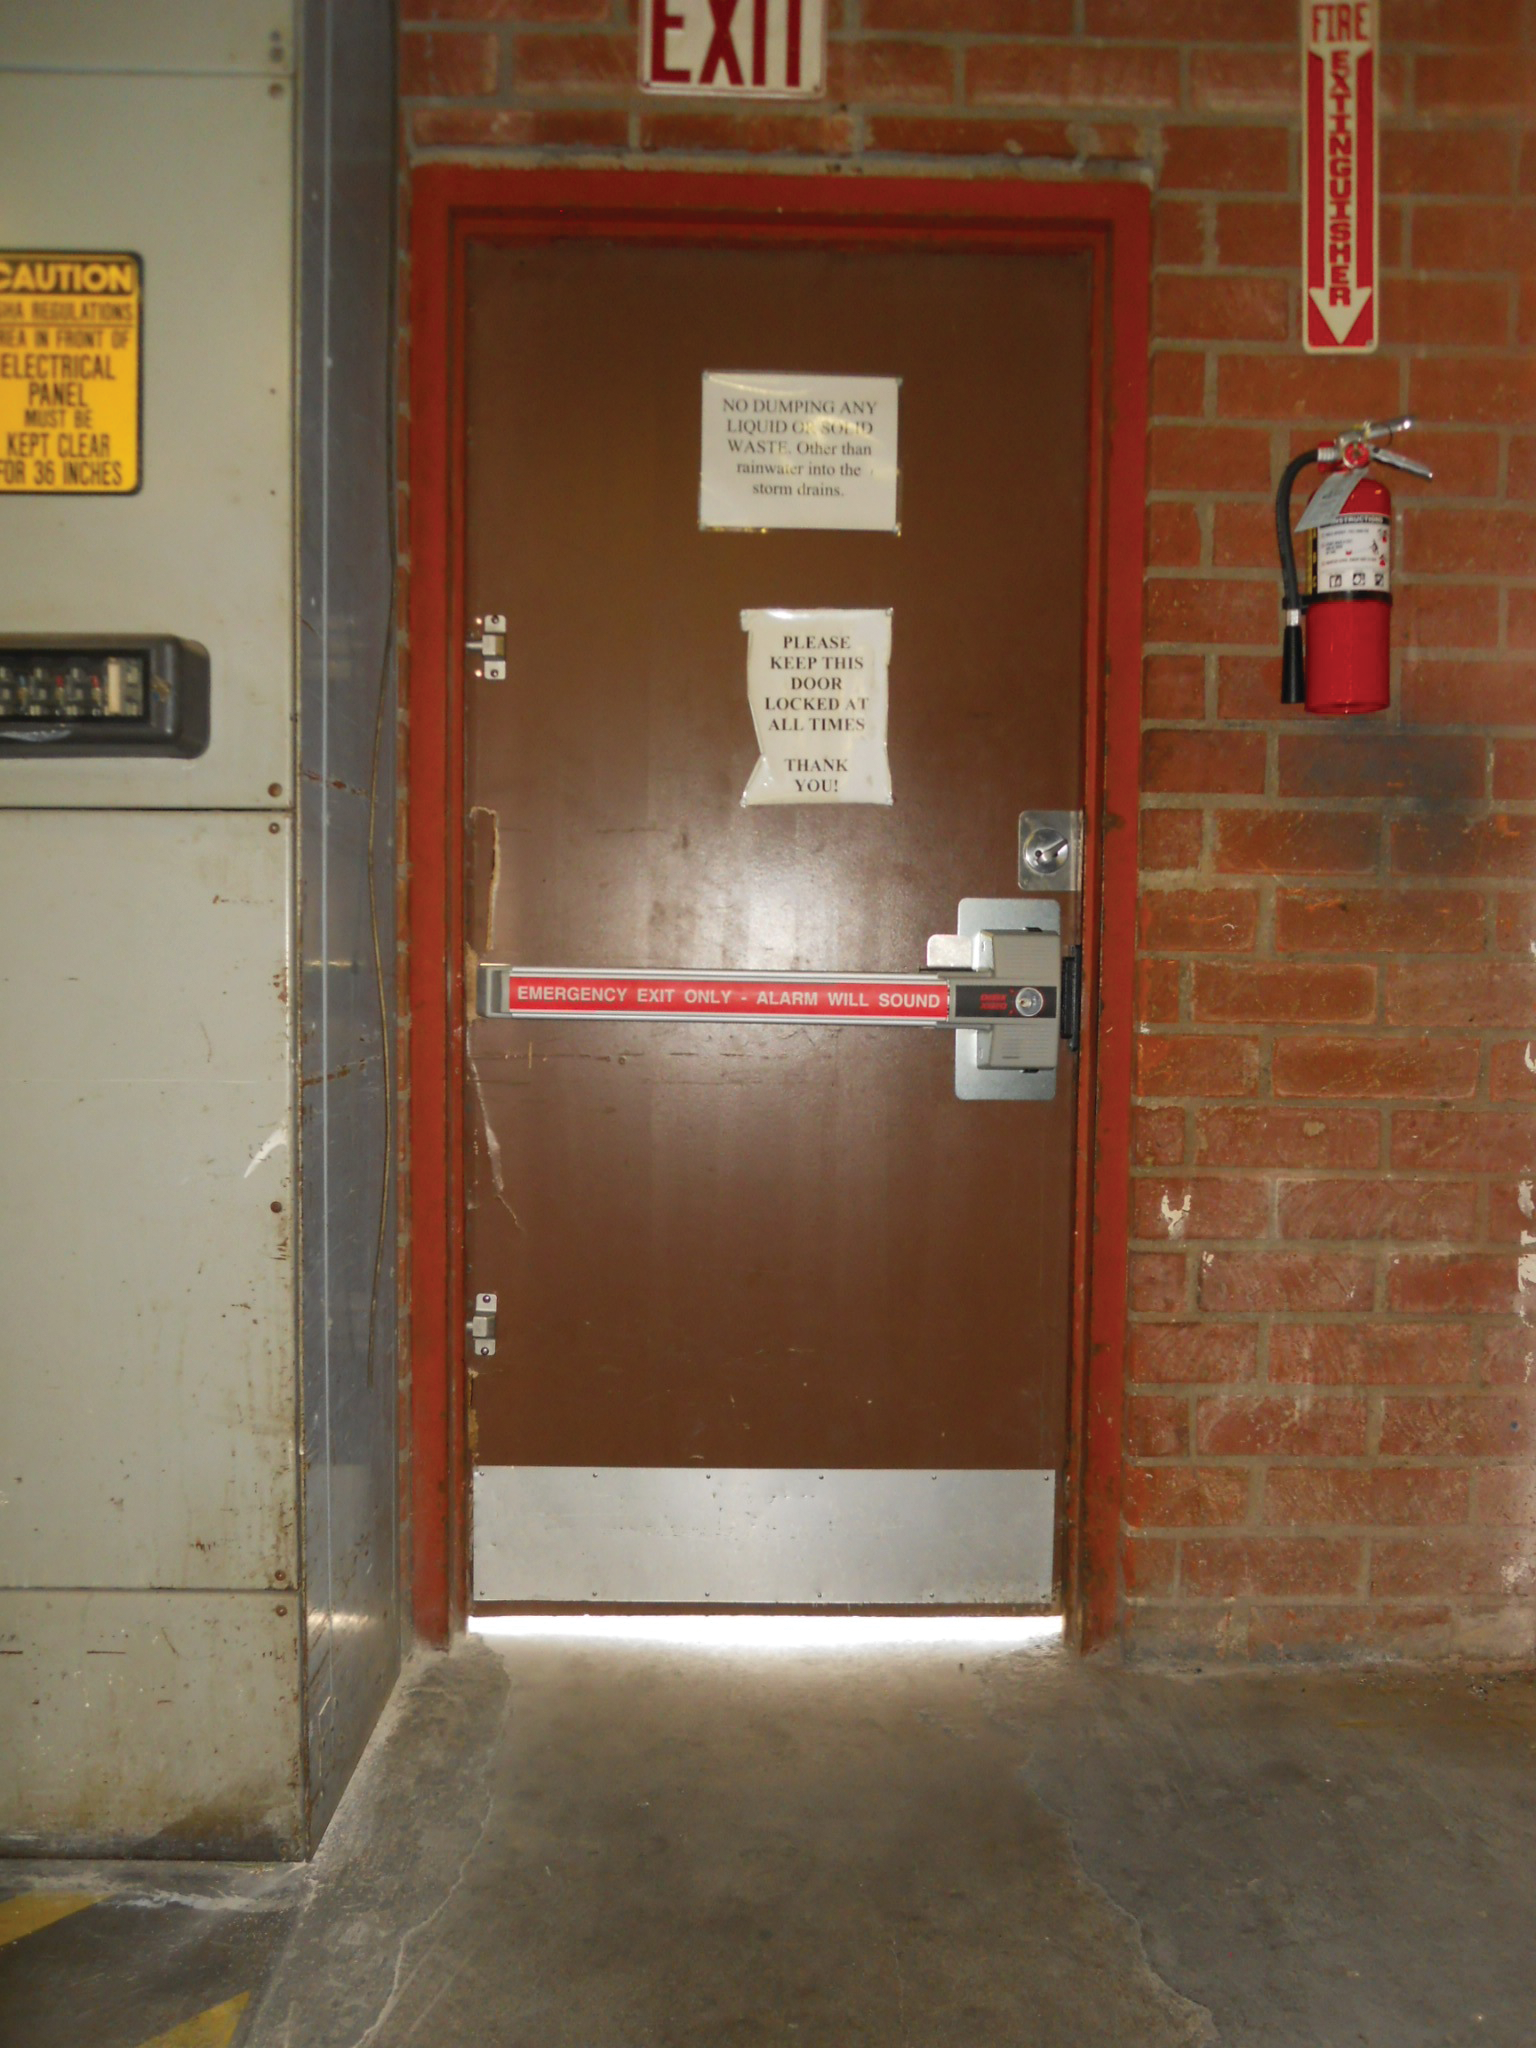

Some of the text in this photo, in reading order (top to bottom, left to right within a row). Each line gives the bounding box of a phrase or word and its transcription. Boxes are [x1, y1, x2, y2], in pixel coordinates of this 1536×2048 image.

[1312, 3, 1369, 43] FIRE
[652, 0, 801, 88] EXIT
[1329, 51, 1351, 307] EXTINGUISHER
[32, 302, 131, 319] REGULATIONS
[35, 328, 49, 348] IN
[56, 328, 103, 348] FRONT
[111, 328, 129, 349] OF
[1, 353, 116, 379] ELECTRICAL
[28, 382, 88, 407] PANEL
[723, 399, 877, 416] NO DUMPING ANY
[24, 409, 93, 429] MUST BE
[727, 419, 873, 435] LIQUID OR SOLID
[7, 432, 110, 458] KEPT CLEAR
[728, 440, 872, 456] WASTE. Other than
[33, 460, 55, 485] 36
[62, 460, 122, 485] INCHES
[737, 462, 861, 477] rainwater into the
[752, 482, 844, 497] storm drains.
[783, 636, 850, 649] PLEASE
[770, 656, 863, 670] KEEP THIS
[791, 677, 842, 690] DOOR
[765, 697, 869, 711] LOCKED AT
[768, 718, 865, 731] ALL TIMES
[784, 758, 848, 772] THANK
[795, 779, 838, 792] YOU!
[517, 986, 628, 1002] EMERGENCY
[637, 988, 675, 1003] EXIT
[684, 989, 732, 1004] ONLY
[756, 991, 818, 1006] ALARM
[827, 992, 869, 1007] WILL
[878, 993, 940, 1008] SOUND
